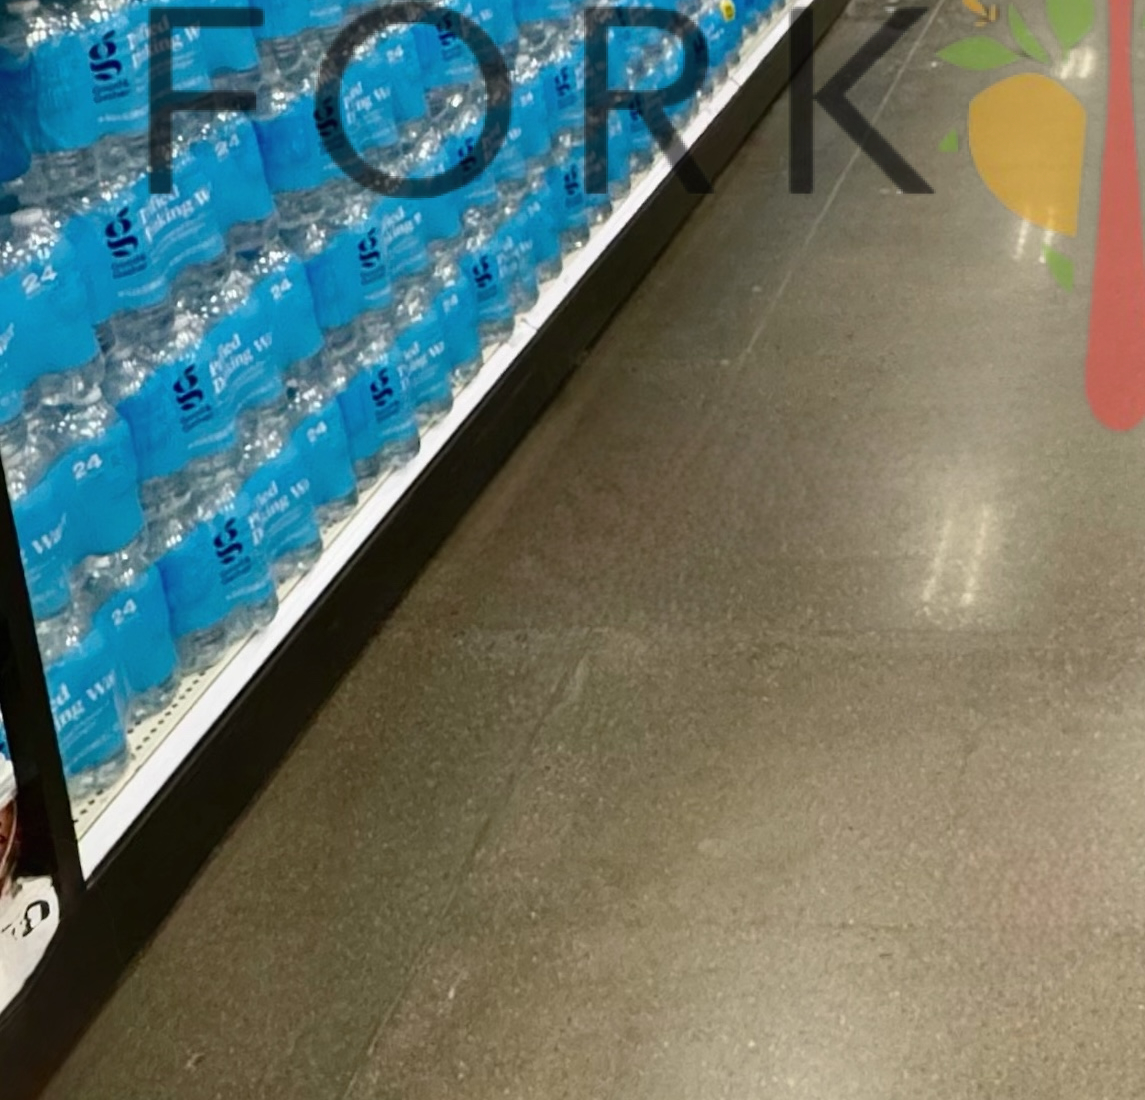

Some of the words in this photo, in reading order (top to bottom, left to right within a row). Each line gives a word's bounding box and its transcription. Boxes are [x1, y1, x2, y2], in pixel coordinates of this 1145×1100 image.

[21, 265, 57, 299] 24
[72, 453, 103, 481] 24
[111, 599, 137, 626] 24
